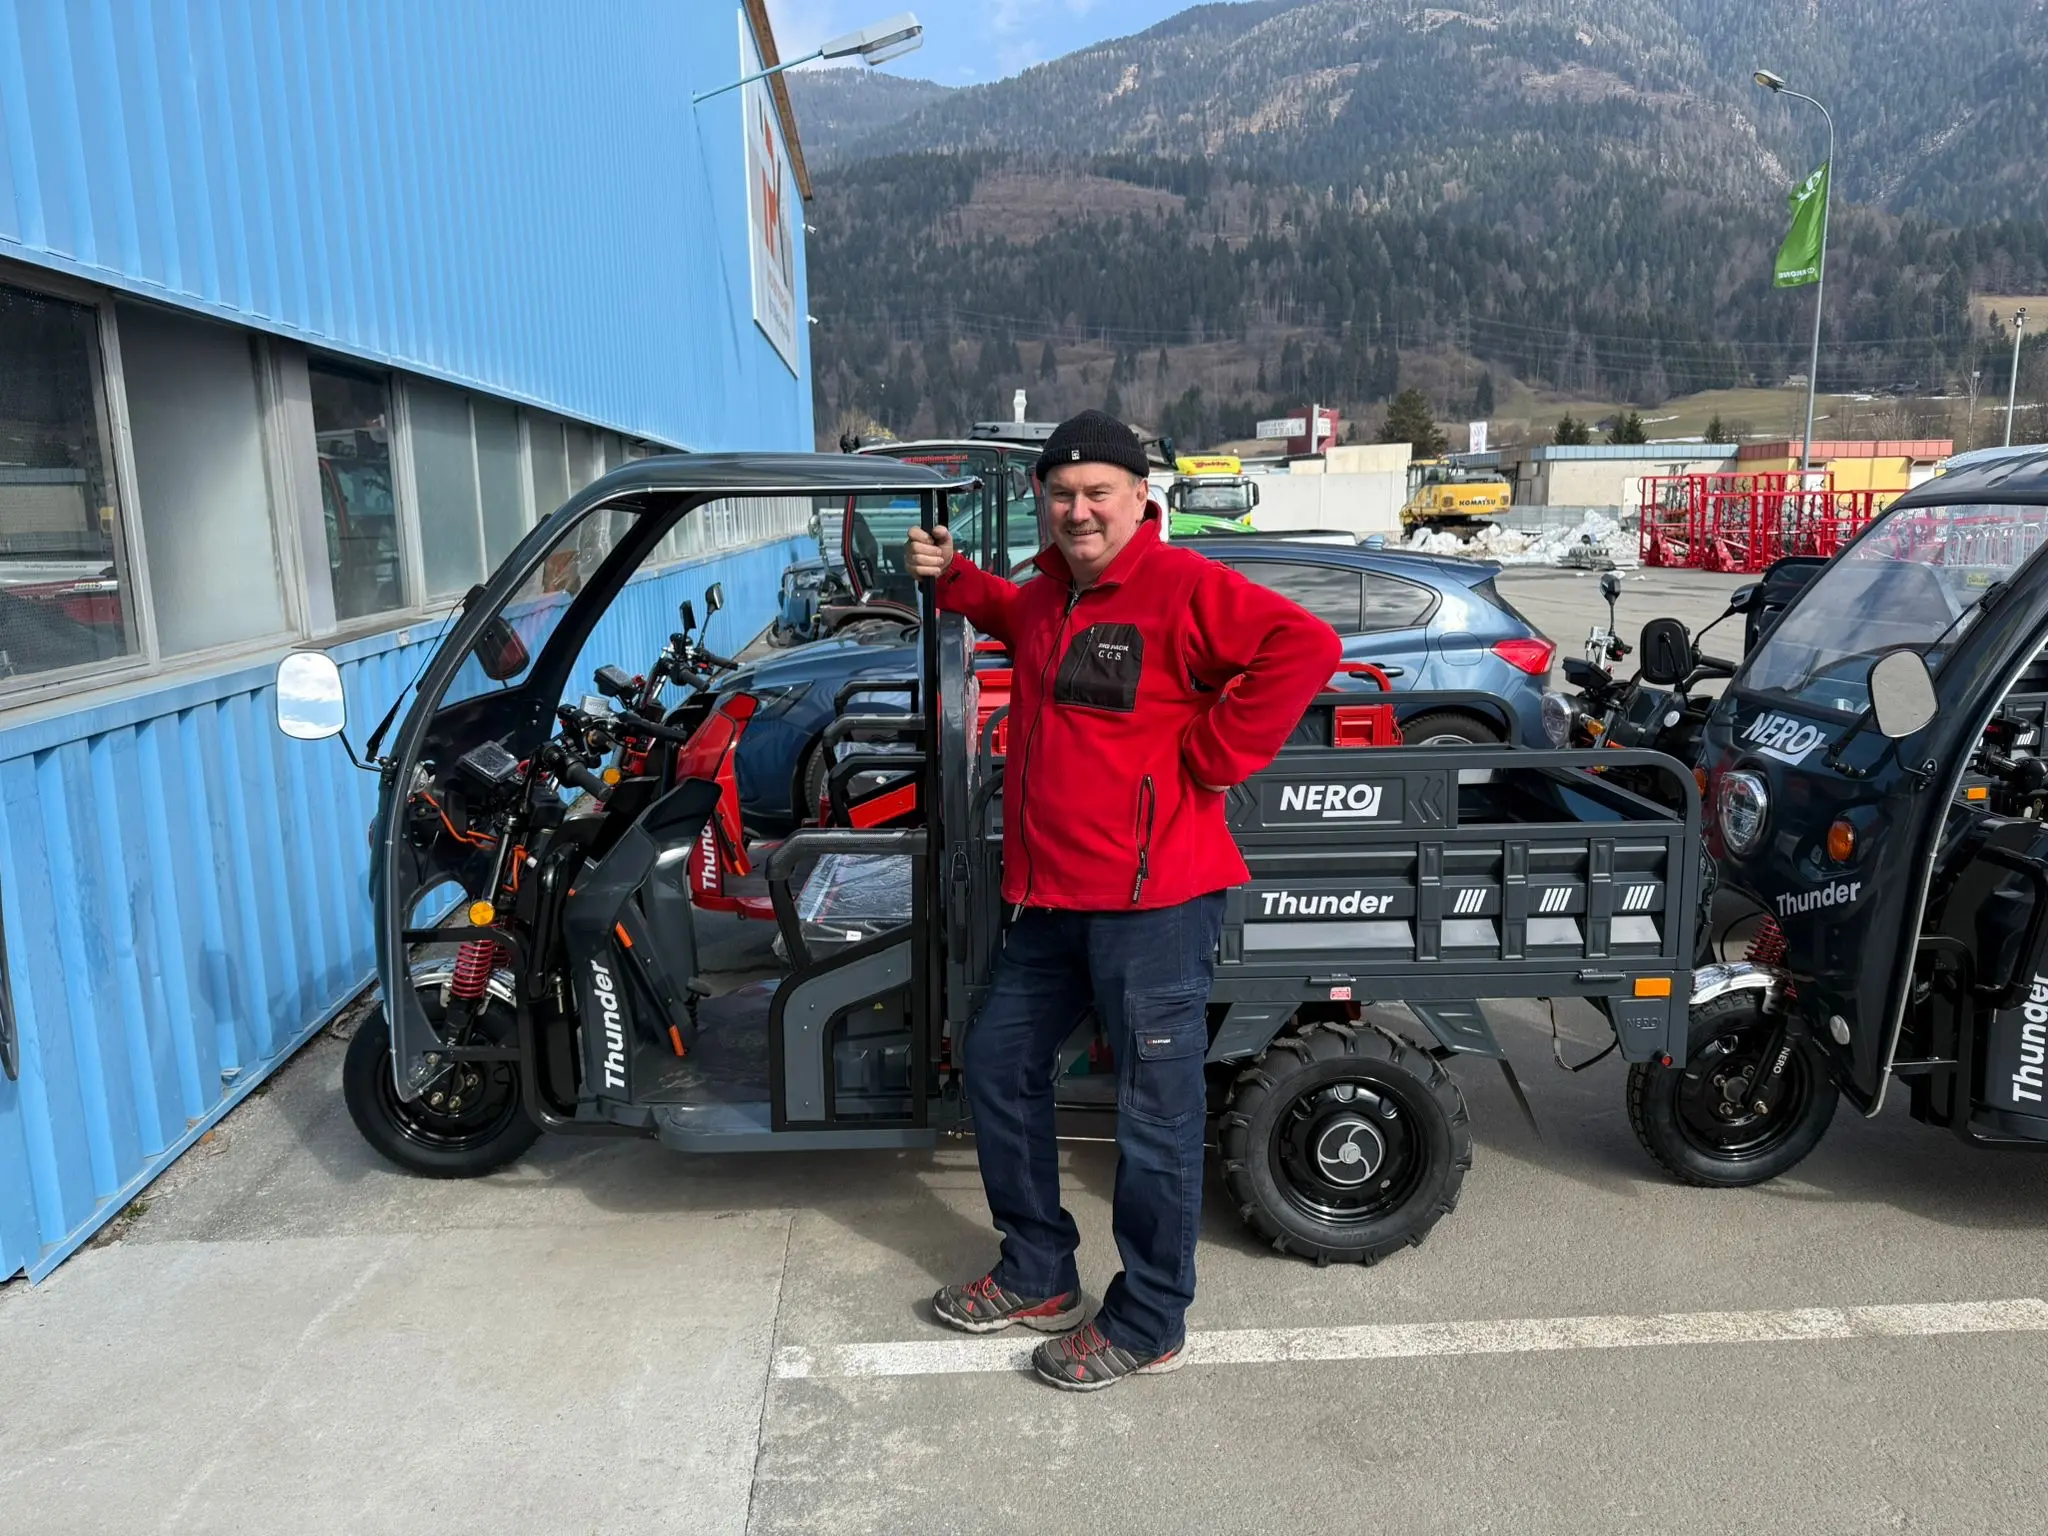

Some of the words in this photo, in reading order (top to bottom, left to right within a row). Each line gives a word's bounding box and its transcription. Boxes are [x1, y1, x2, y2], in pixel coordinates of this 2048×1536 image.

[1740, 712, 1823, 762] NERO
[1280, 784, 1377, 814] NERO
[701, 819, 717, 890] Thund
[1261, 890, 1394, 915] Thunder
[1776, 881, 1861, 917] Thunder
[590, 959, 625, 1089] Thunder
[2012, 971, 2048, 1102] Thunder
[1773, 1046, 1791, 1074] NERO
